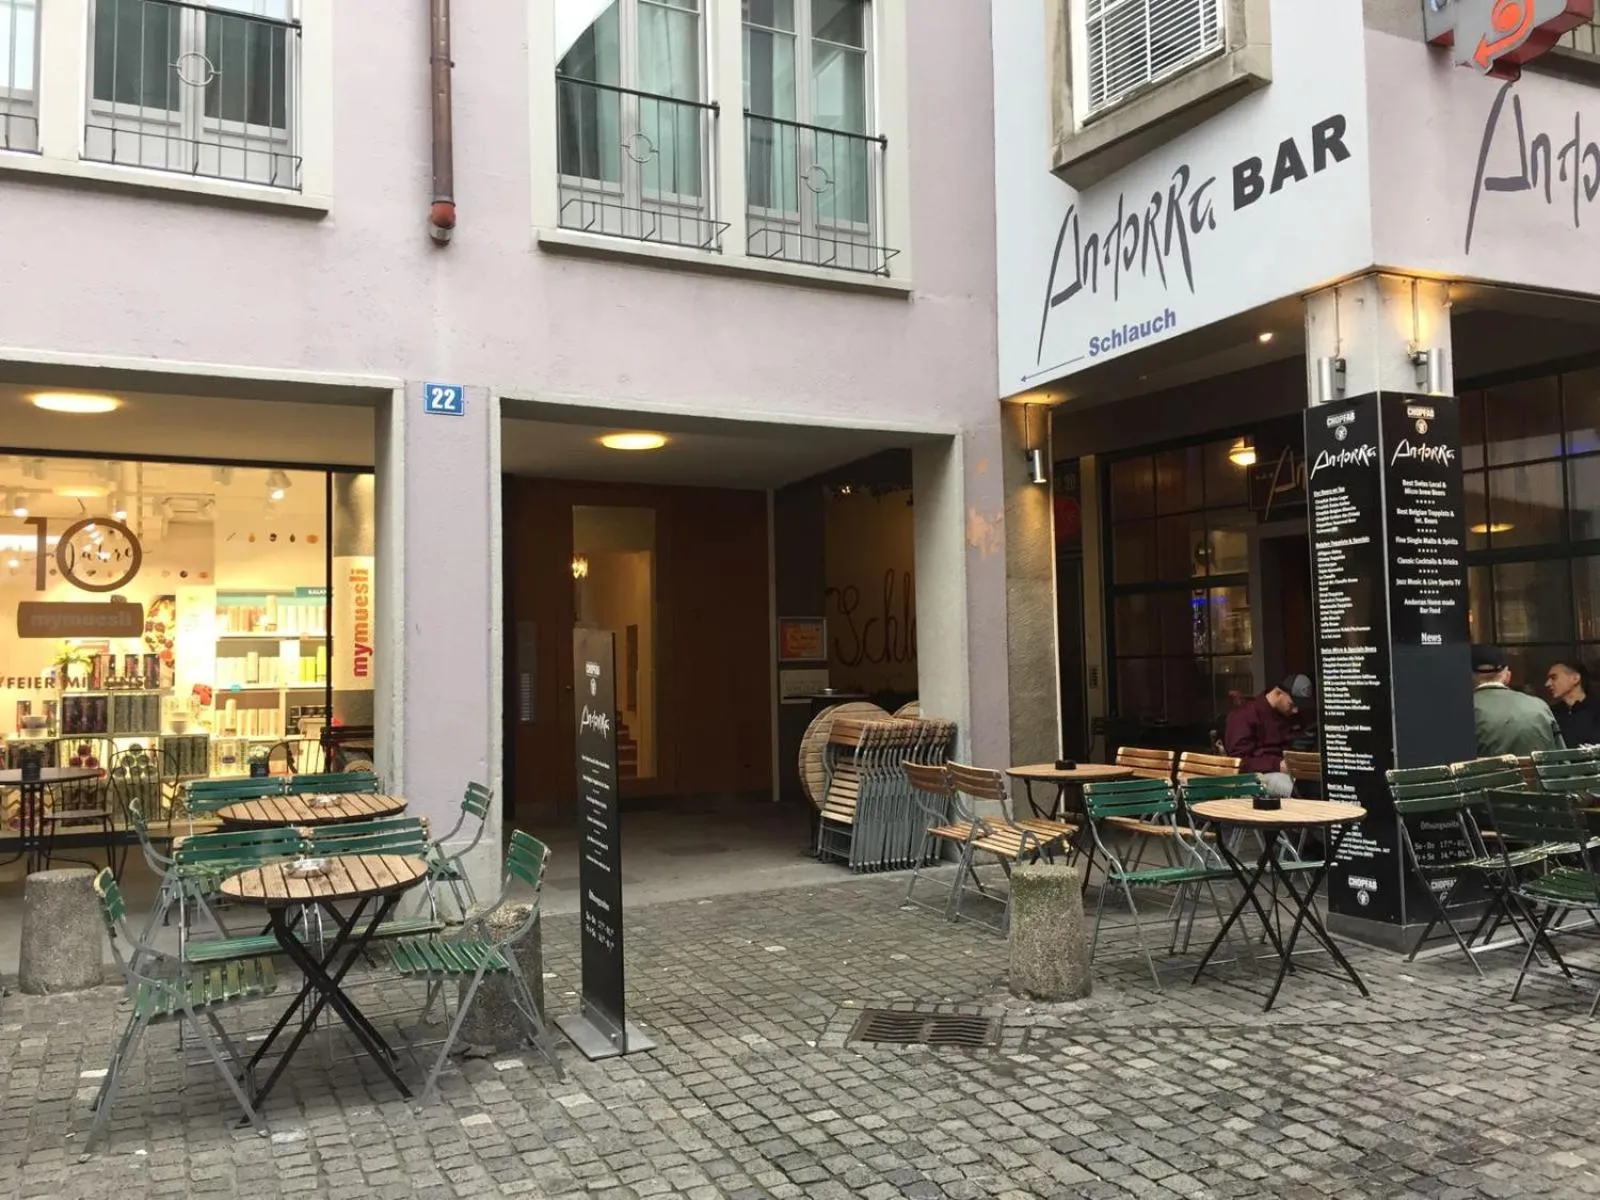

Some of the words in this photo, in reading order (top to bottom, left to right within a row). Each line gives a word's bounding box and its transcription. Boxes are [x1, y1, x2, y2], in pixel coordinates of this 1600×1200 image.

[1233, 113, 1351, 211] BAR
[1088, 307, 1177, 357] Schlauch
[431, 387, 456, 410] 22
[24, 516, 142, 592] 10
[350, 568, 374, 677] mymuesli
[1421, 632, 1442, 643] News
